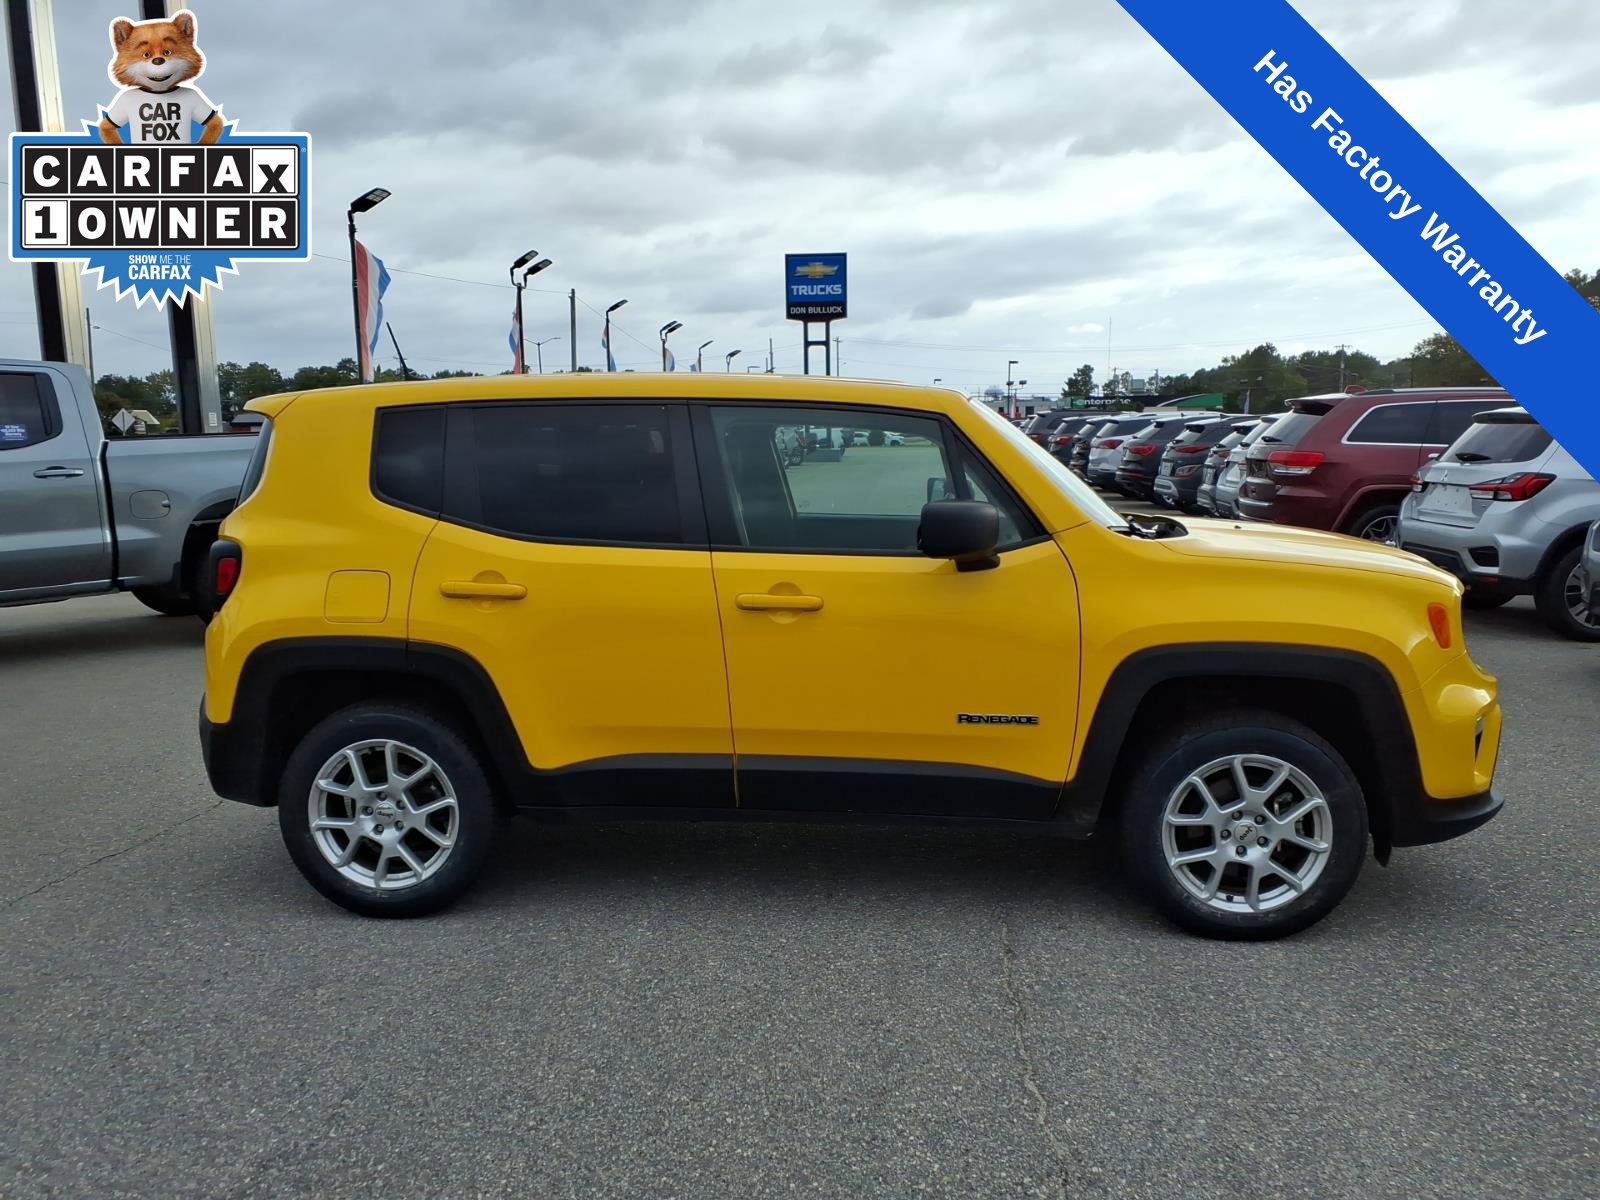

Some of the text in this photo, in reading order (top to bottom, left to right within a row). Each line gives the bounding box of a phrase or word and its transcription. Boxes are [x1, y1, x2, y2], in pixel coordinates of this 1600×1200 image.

[791, 284, 842, 295] TRUCKS
[808, 306, 842, 314] BULLUCK
[957, 713, 1040, 725] RENEGADE
